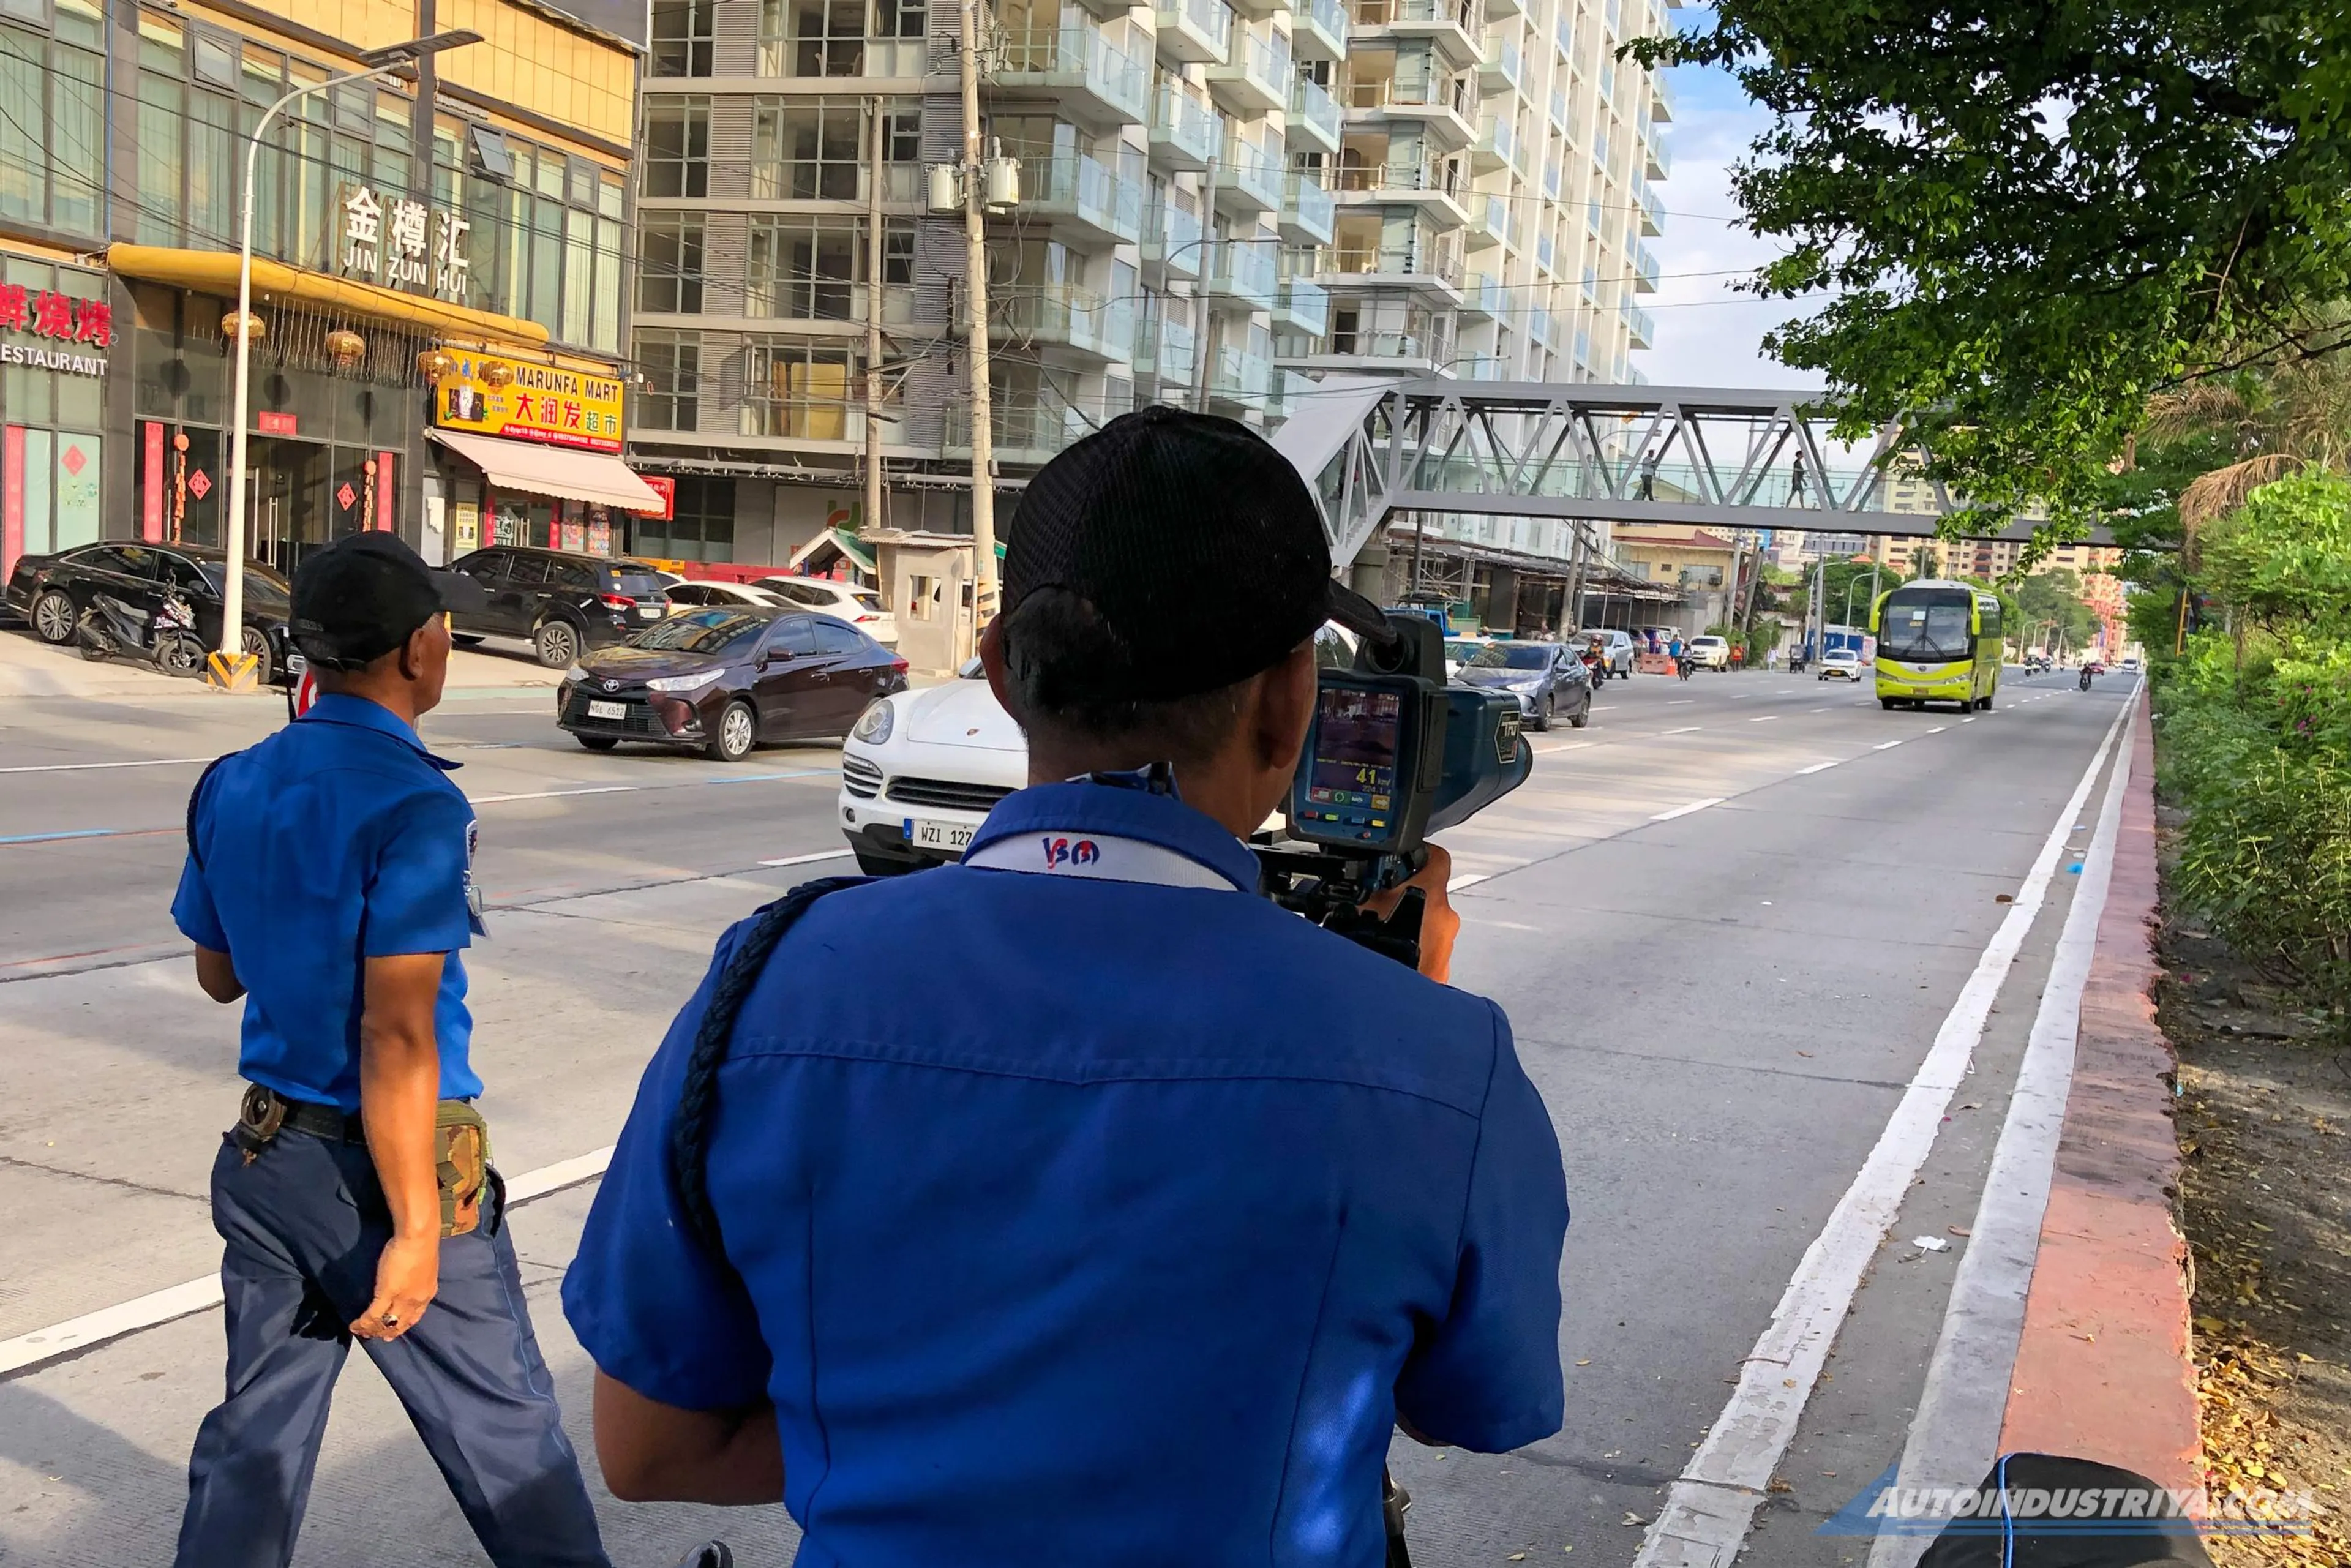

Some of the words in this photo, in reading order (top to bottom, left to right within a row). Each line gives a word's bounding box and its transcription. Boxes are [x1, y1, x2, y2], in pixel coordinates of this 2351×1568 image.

[346, 186, 470, 268] 金樽汇
[343, 246, 378, 273] JIN
[388, 256, 427, 285] ZUN
[437, 268, 467, 295] HUI
[516, 366, 578, 396] MARUNFA
[585, 380, 618, 402] MART
[1356, 768, 1376, 784] 41
[921, 827, 941, 842] WZI
[950, 830, 972, 846] 127
